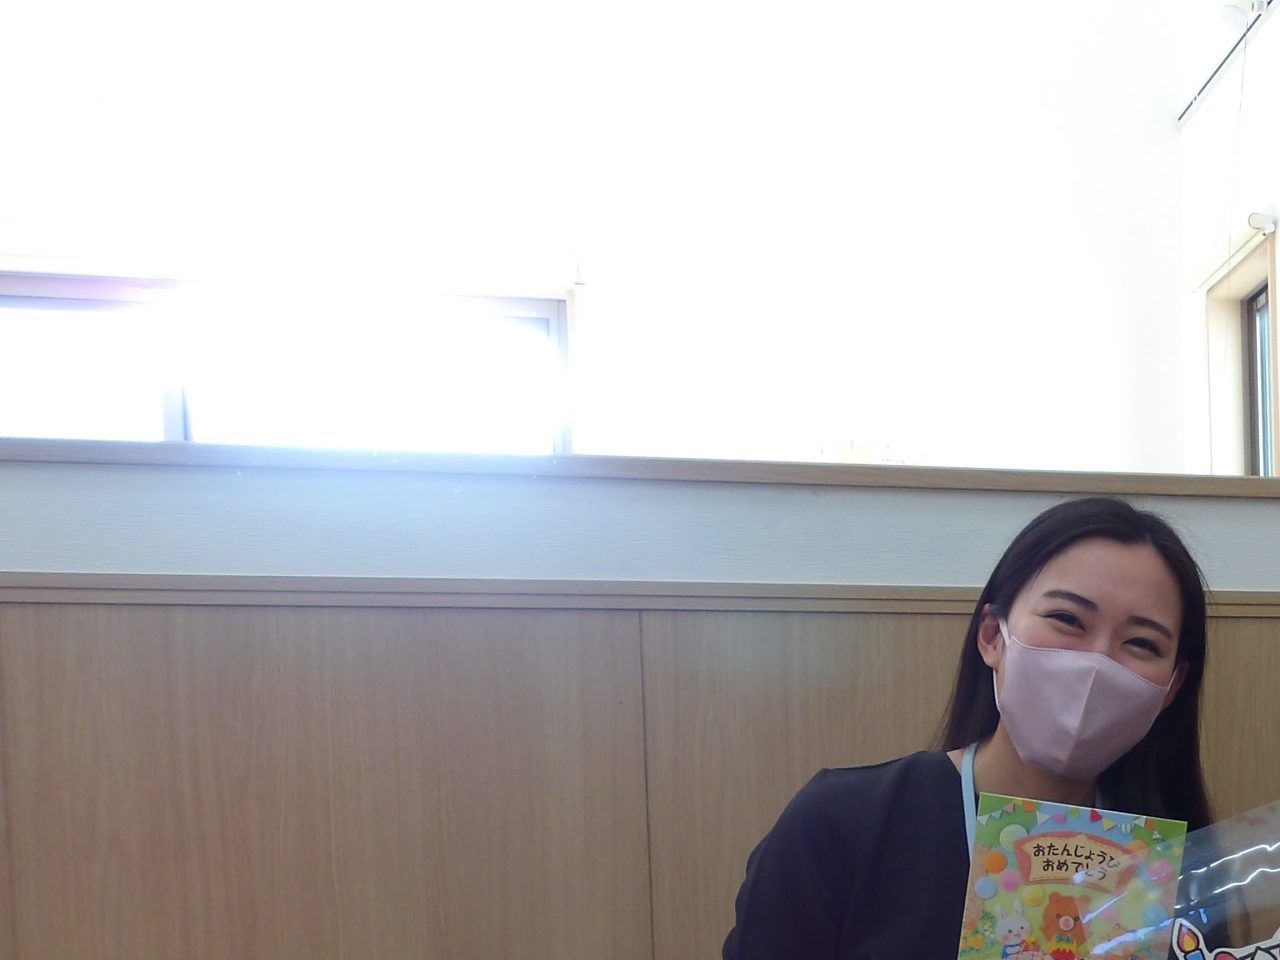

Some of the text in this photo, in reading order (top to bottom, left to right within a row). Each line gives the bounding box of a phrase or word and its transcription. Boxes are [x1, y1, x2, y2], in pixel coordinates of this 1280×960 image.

[1033, 843, 1120, 868] おたんじょうび
